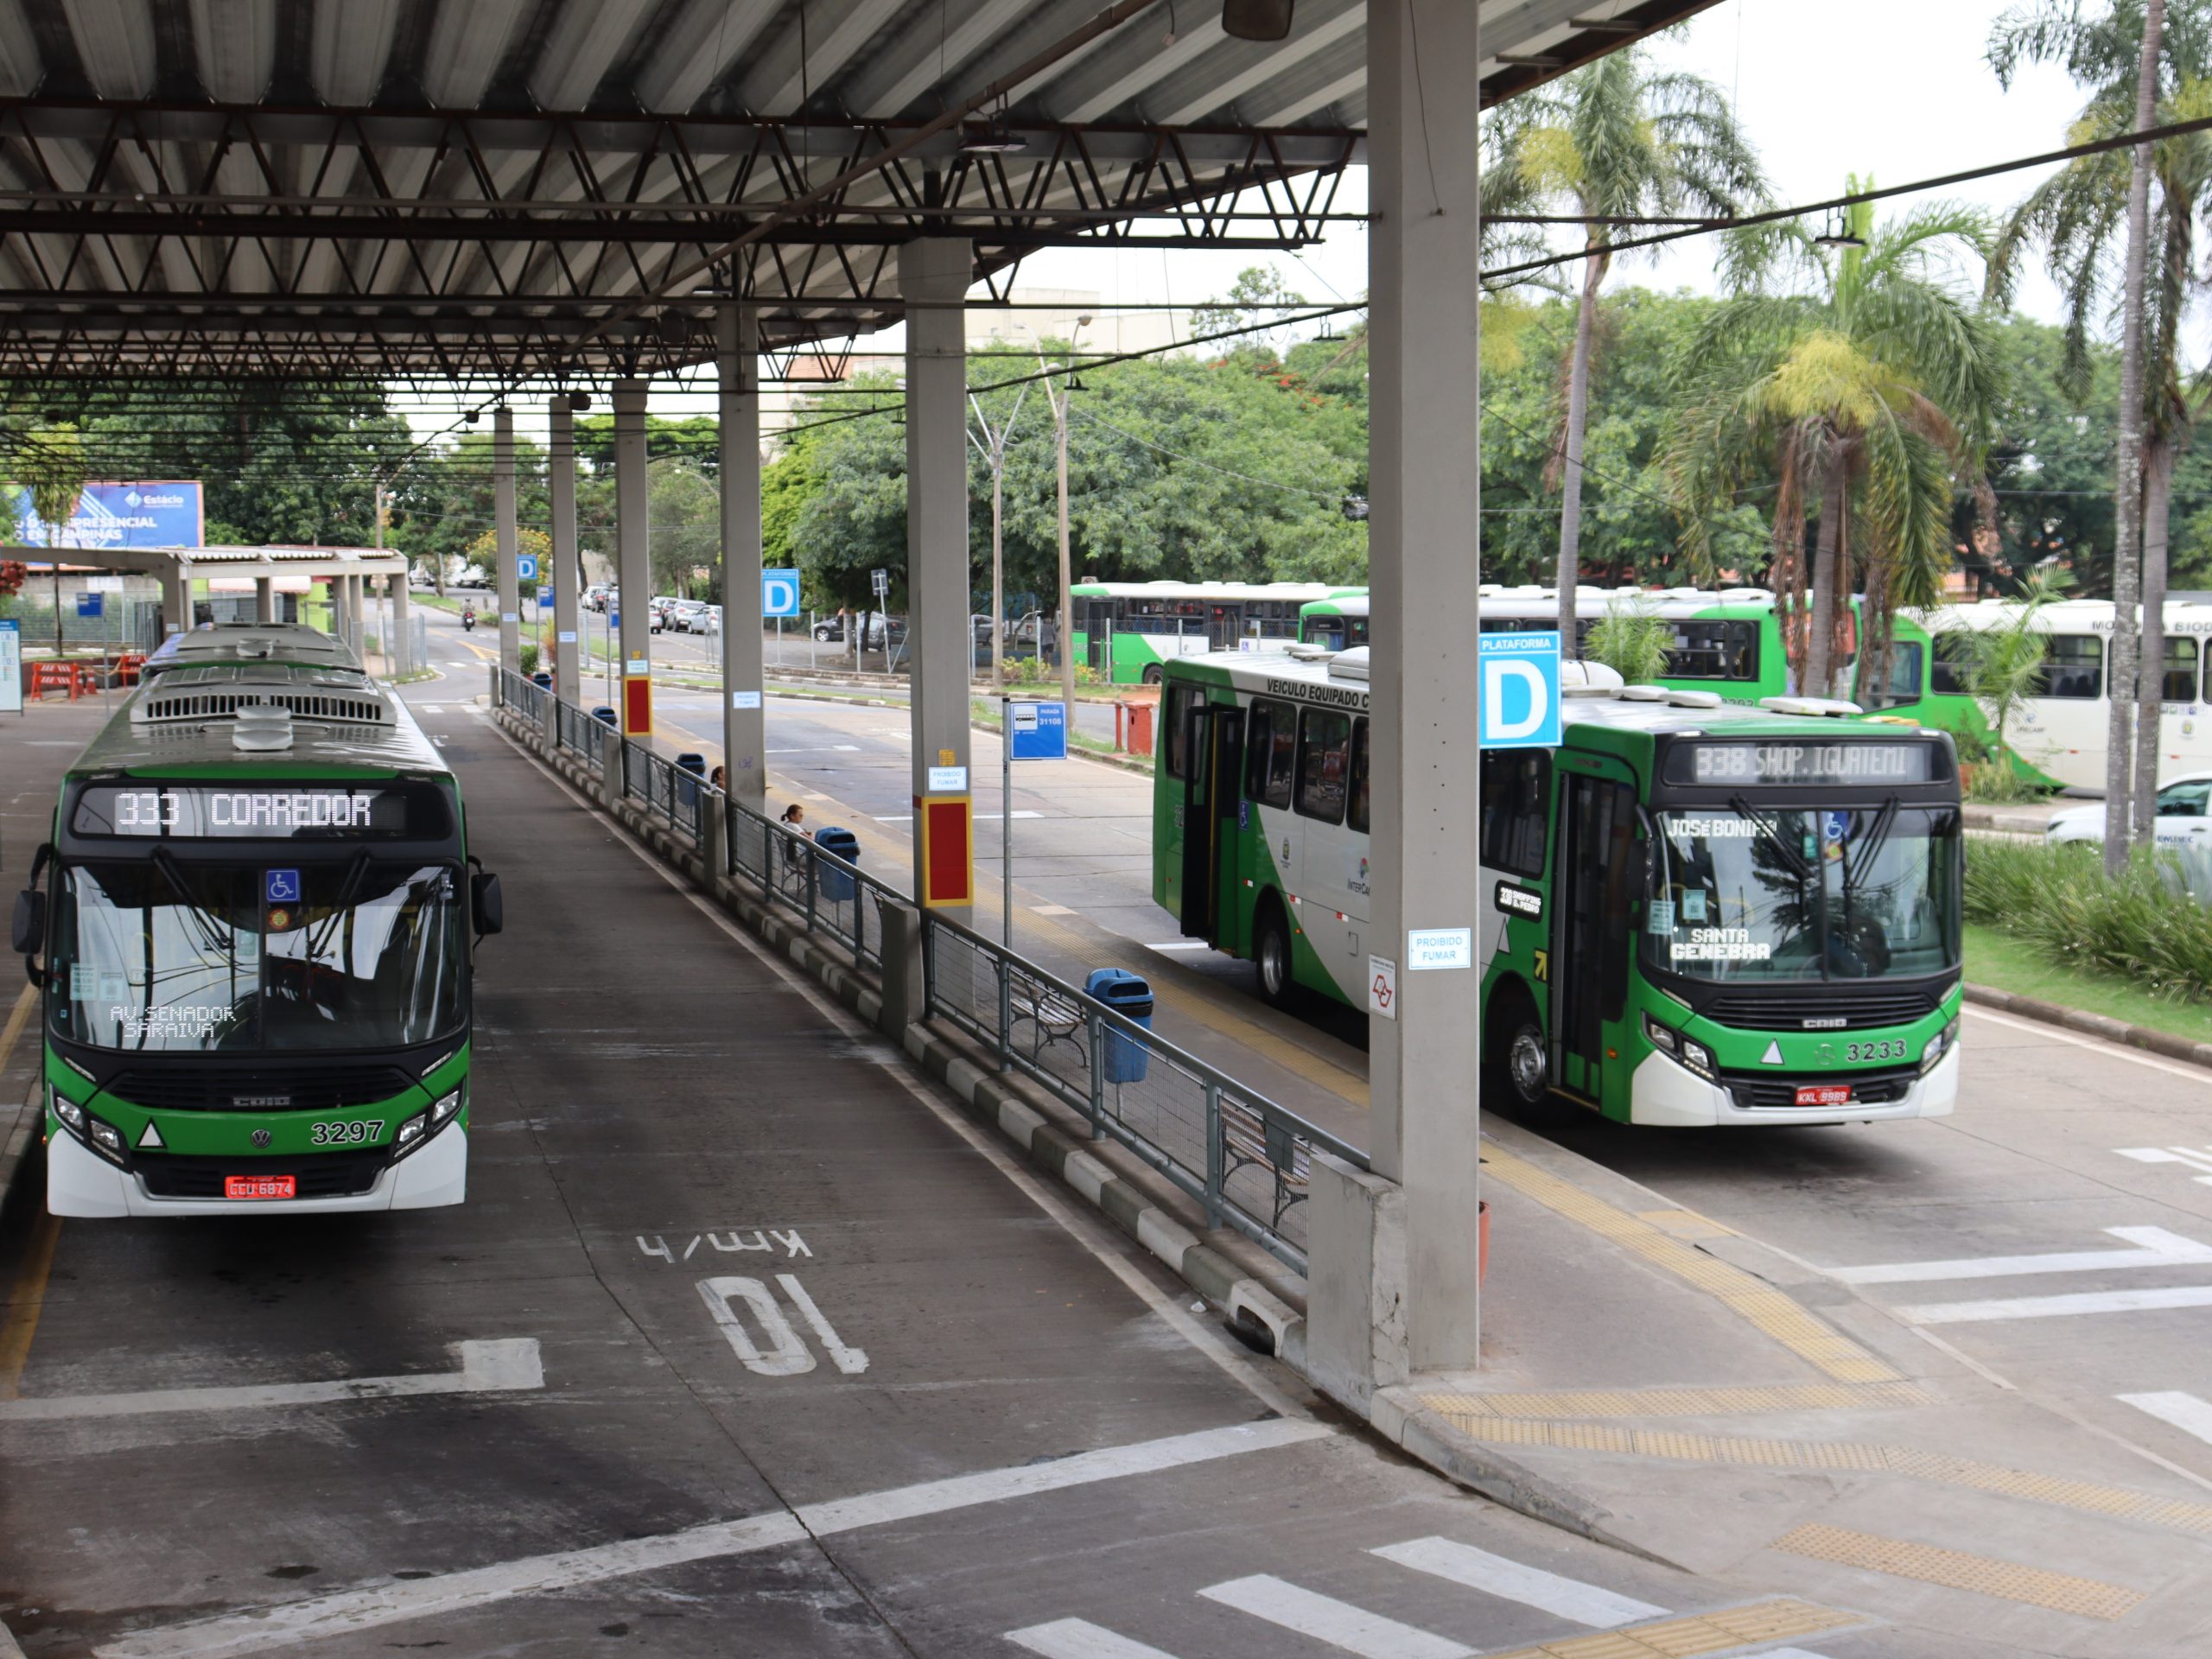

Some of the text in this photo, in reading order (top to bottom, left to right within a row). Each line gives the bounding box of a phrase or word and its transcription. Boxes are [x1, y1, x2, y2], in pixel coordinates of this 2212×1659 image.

[519, 561, 533, 577] D
[765, 581, 793, 613] D
[1482, 639, 1552, 651] PLATAFORMA
[1268, 678, 1306, 697] VEICULO
[1309, 685, 1359, 707] EQUIPADO
[1485, 659, 1548, 739] D
[1695, 747, 1748, 776] 338
[119, 793, 371, 826] 333 CORREDOR
[1416, 936, 1463, 947] PROIBIDO
[1691, 928, 1749, 944] SANTA
[1422, 950, 1456, 961] FUMAR
[1670, 943, 1770, 960] GENEBRA
[124, 1023, 214, 1038] SARAIVA
[1846, 1039, 1908, 1063] 3233
[1797, 1092, 1817, 1103] KXL
[310, 1120, 385, 1146] 3297
[695, 1274, 870, 1376] 10
